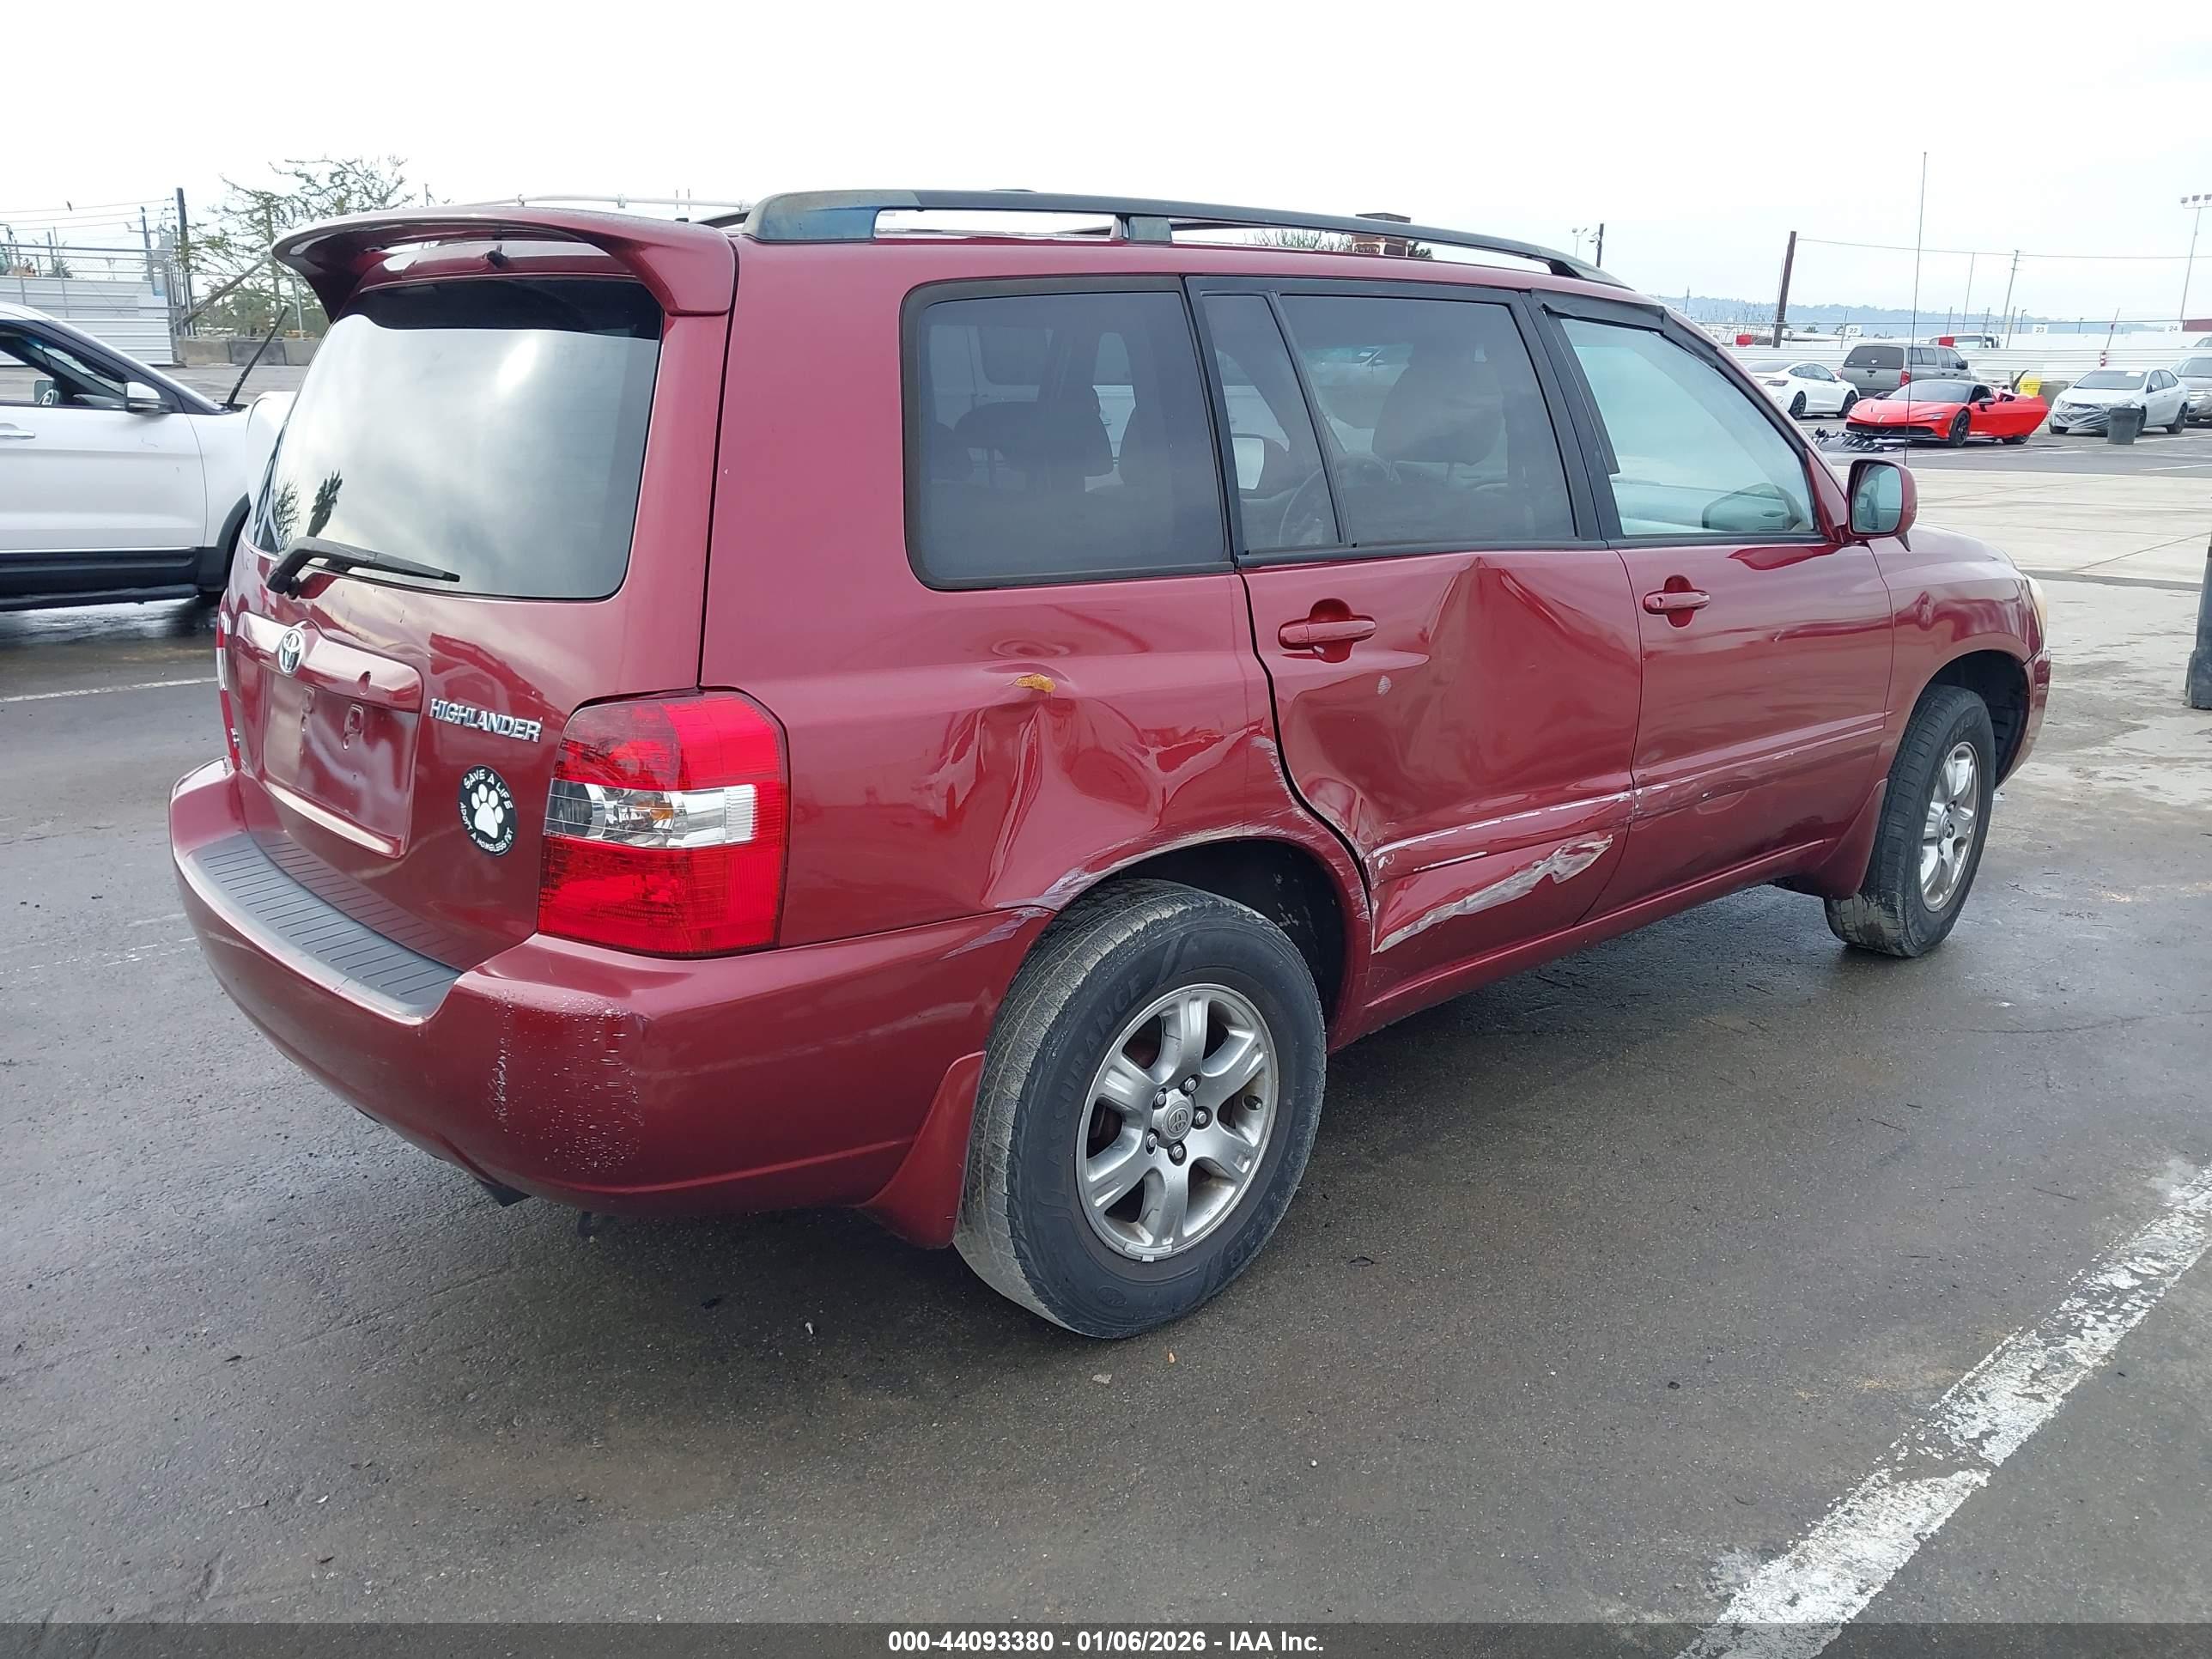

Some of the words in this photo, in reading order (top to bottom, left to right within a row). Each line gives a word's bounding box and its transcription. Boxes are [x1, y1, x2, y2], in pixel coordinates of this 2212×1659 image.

[429, 698, 541, 743] HIGHLANDER
[464, 769, 486, 789] SAVE
[487, 773, 495, 785] A
[495, 782, 514, 810] LIFE
[459, 802, 473, 830] ADOPT
[470, 832, 477, 841] A
[477, 838, 507, 852] HOMELESS
